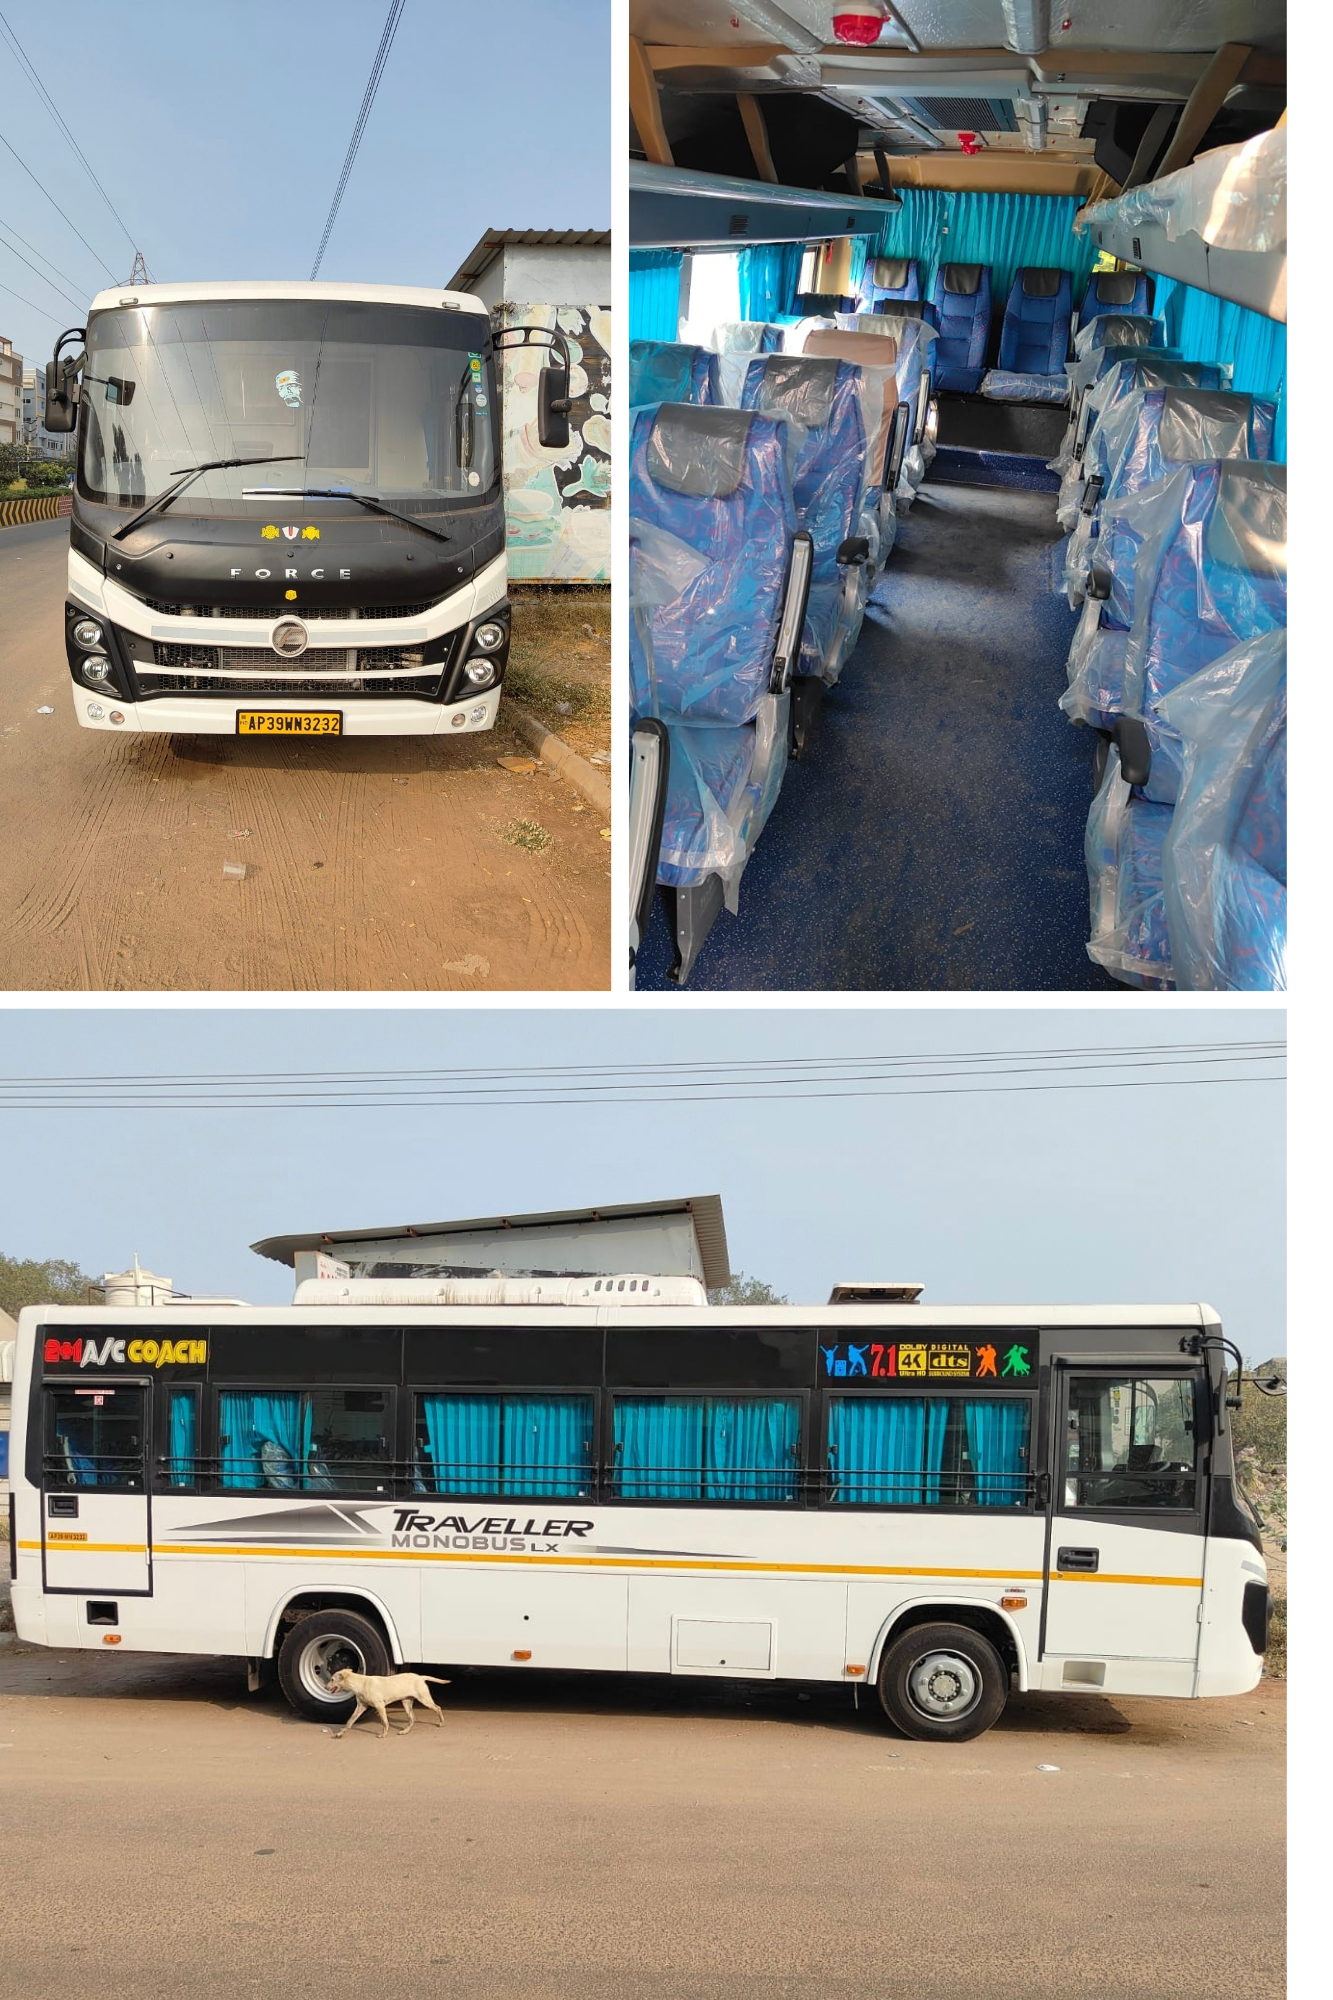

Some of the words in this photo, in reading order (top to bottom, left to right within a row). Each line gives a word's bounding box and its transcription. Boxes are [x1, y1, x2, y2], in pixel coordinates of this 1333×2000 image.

[230, 568, 351, 579] FORCE
[248, 716, 339, 731] AP39WN3232
[79, 1337, 125, 1368] A/C
[127, 1339, 207, 1369] COACH
[870, 1344, 897, 1377] 7.1
[901, 1353, 922, 1368] 4K
[932, 1354, 968, 1368] dts
[393, 1509, 595, 1538] TRAVELLER
[391, 1533, 526, 1551] MONOBUS
[531, 1543, 559, 1553] LX
